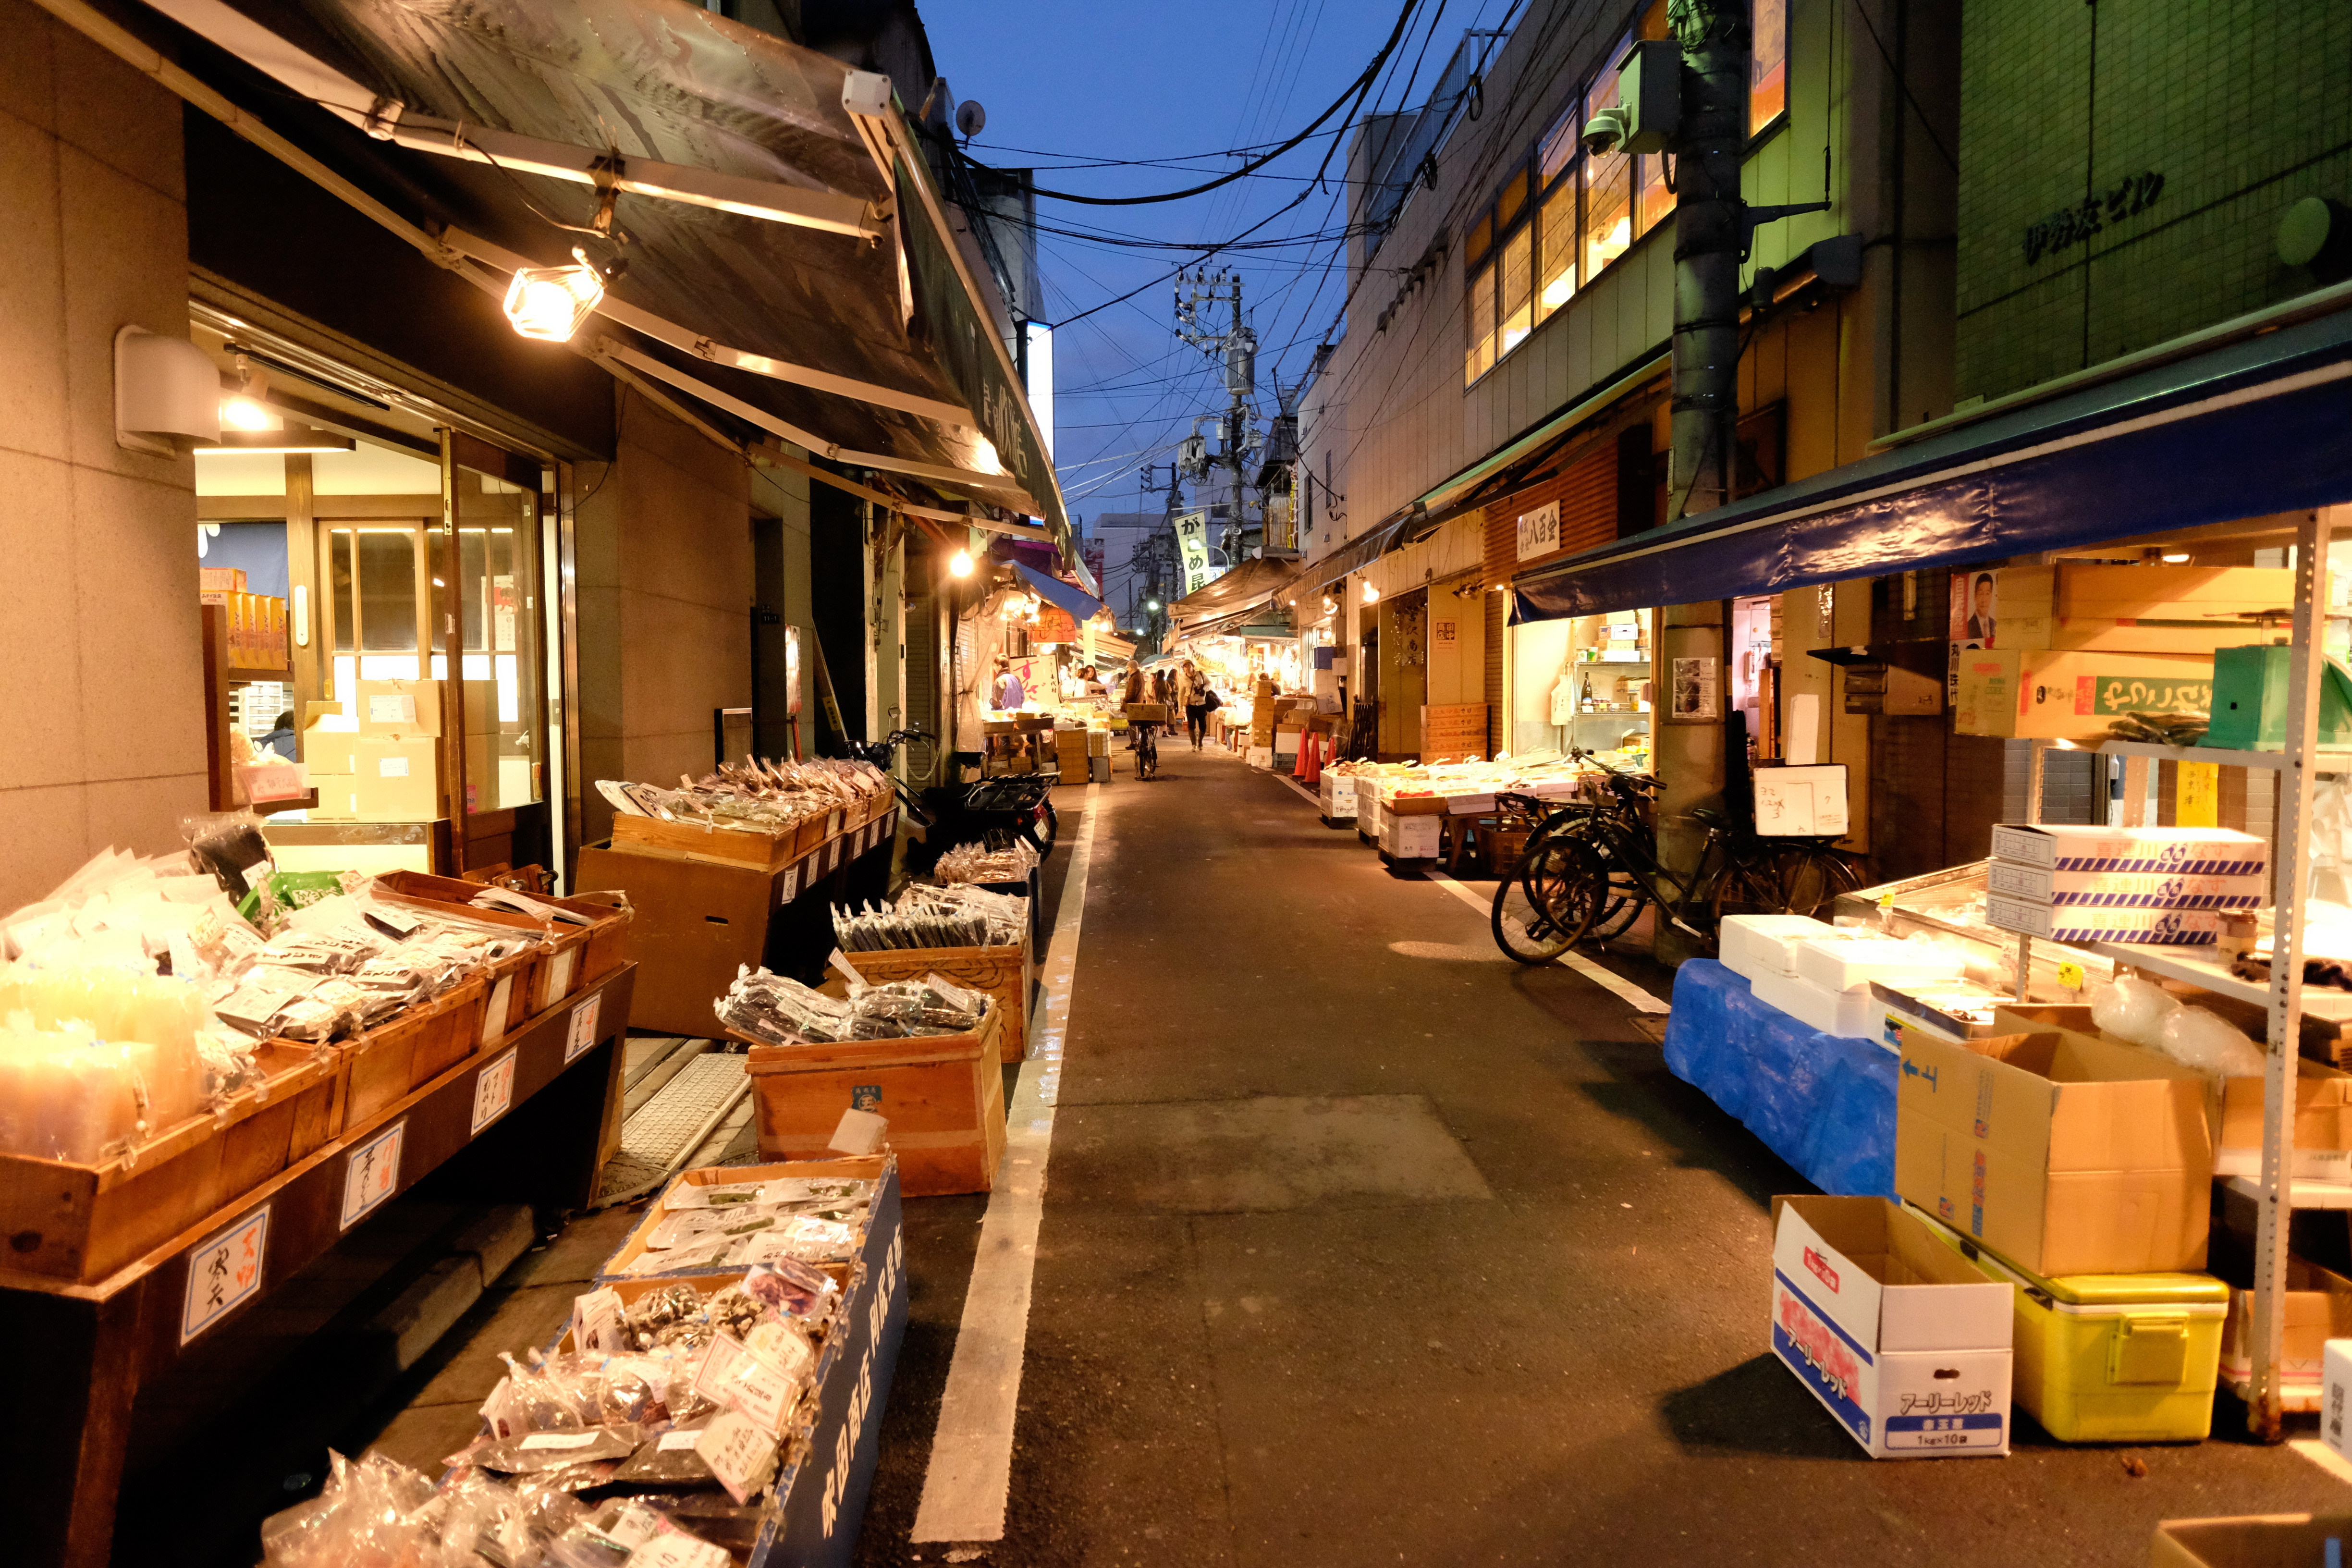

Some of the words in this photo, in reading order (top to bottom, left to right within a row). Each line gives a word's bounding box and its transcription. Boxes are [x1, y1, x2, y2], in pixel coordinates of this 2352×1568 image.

[1900, 1389, 1992, 1416] アーリーレッド
